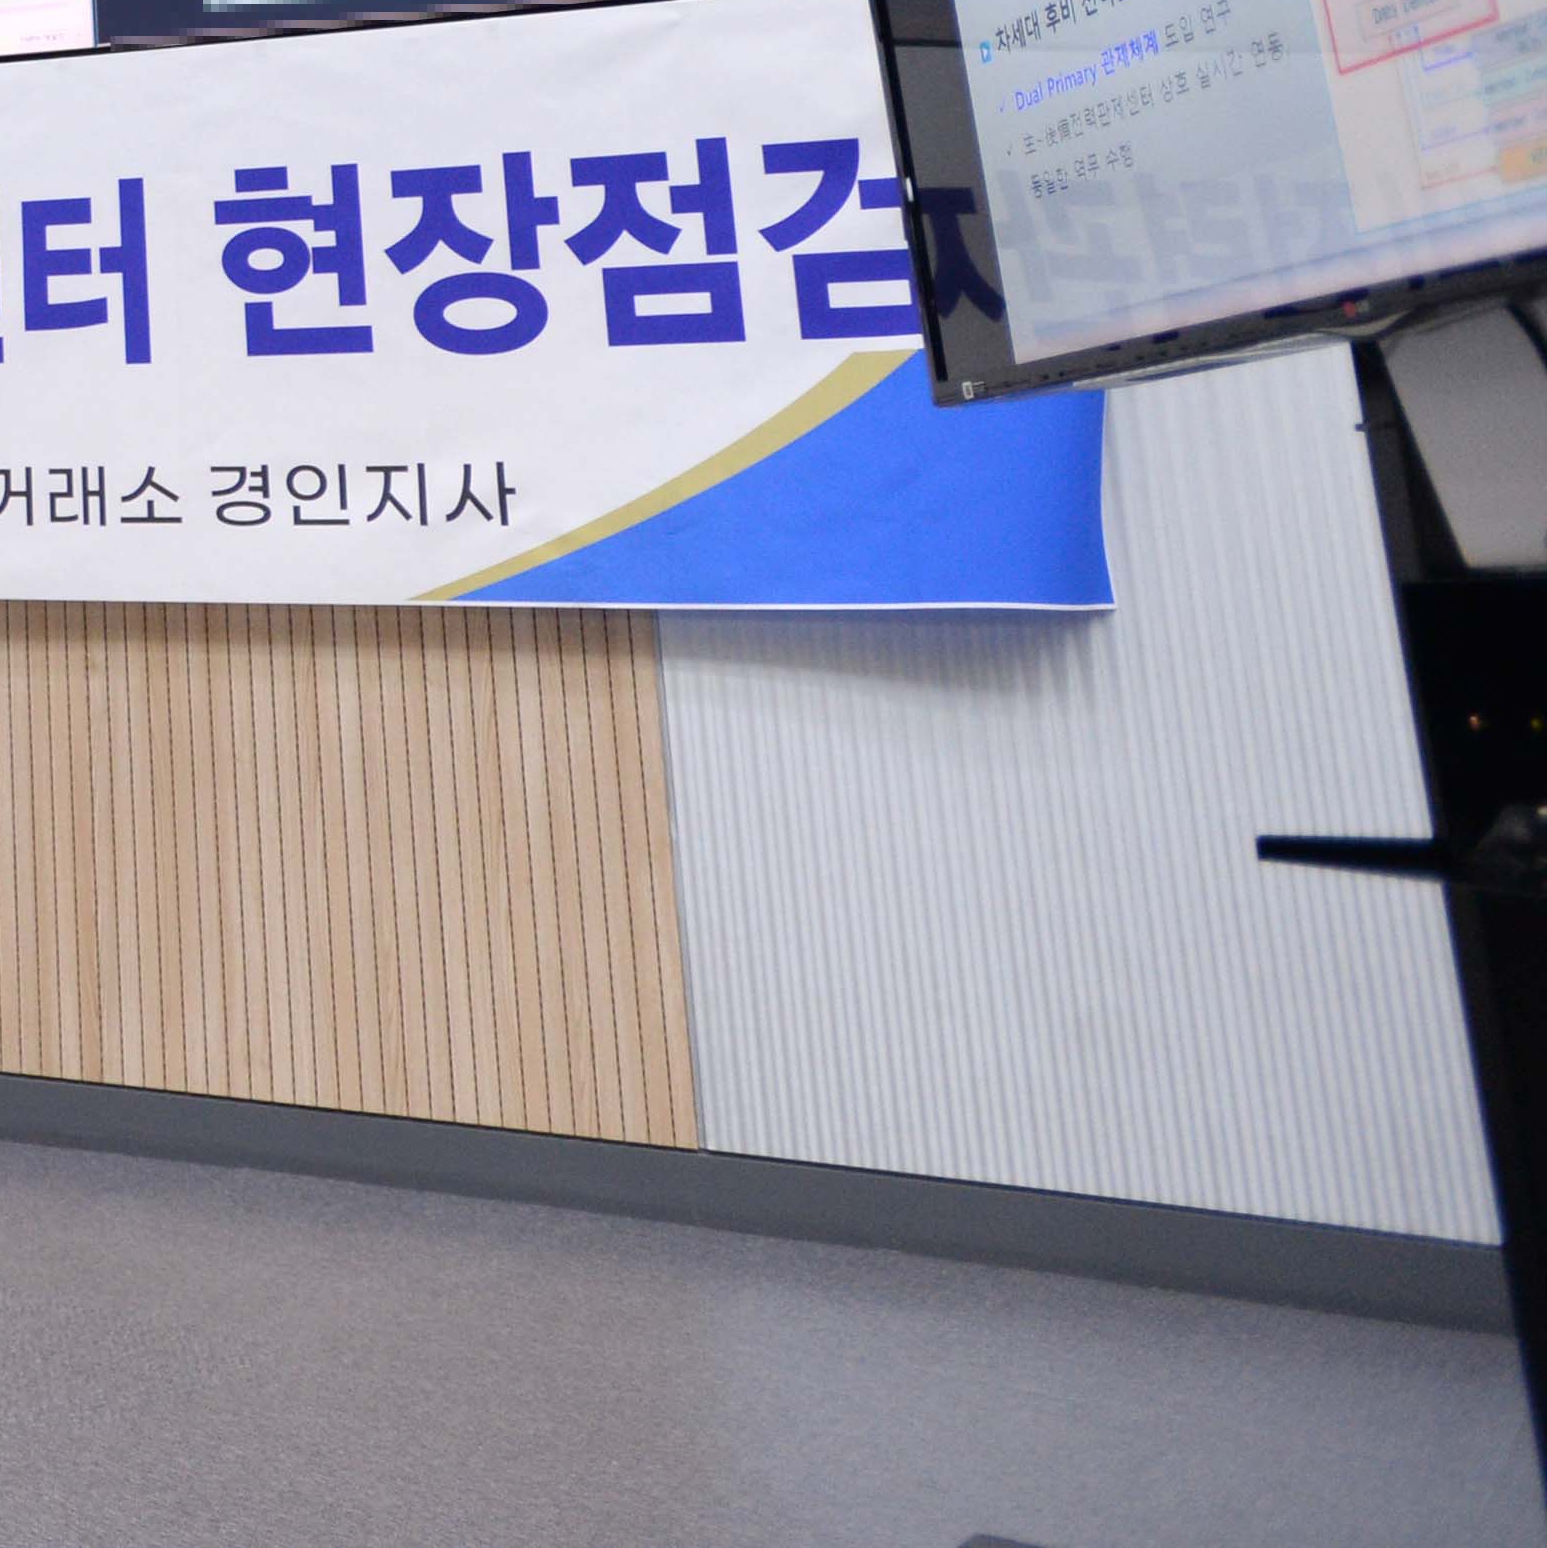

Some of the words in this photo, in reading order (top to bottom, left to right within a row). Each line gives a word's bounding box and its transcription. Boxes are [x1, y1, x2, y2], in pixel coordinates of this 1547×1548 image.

[995, 9, 1041, 54] 차세대
[1015, 82, 1044, 111] Dual
[1047, 65, 1097, 96] Primary
[1100, 29, 1160, 75] 관제체계
[1164, 15, 1195, 48] 도입
[1200, 0, 1231, 35] 연구
[214, 137, 920, 358] 현장점검
[209, 460, 516, 528] 경인지사
